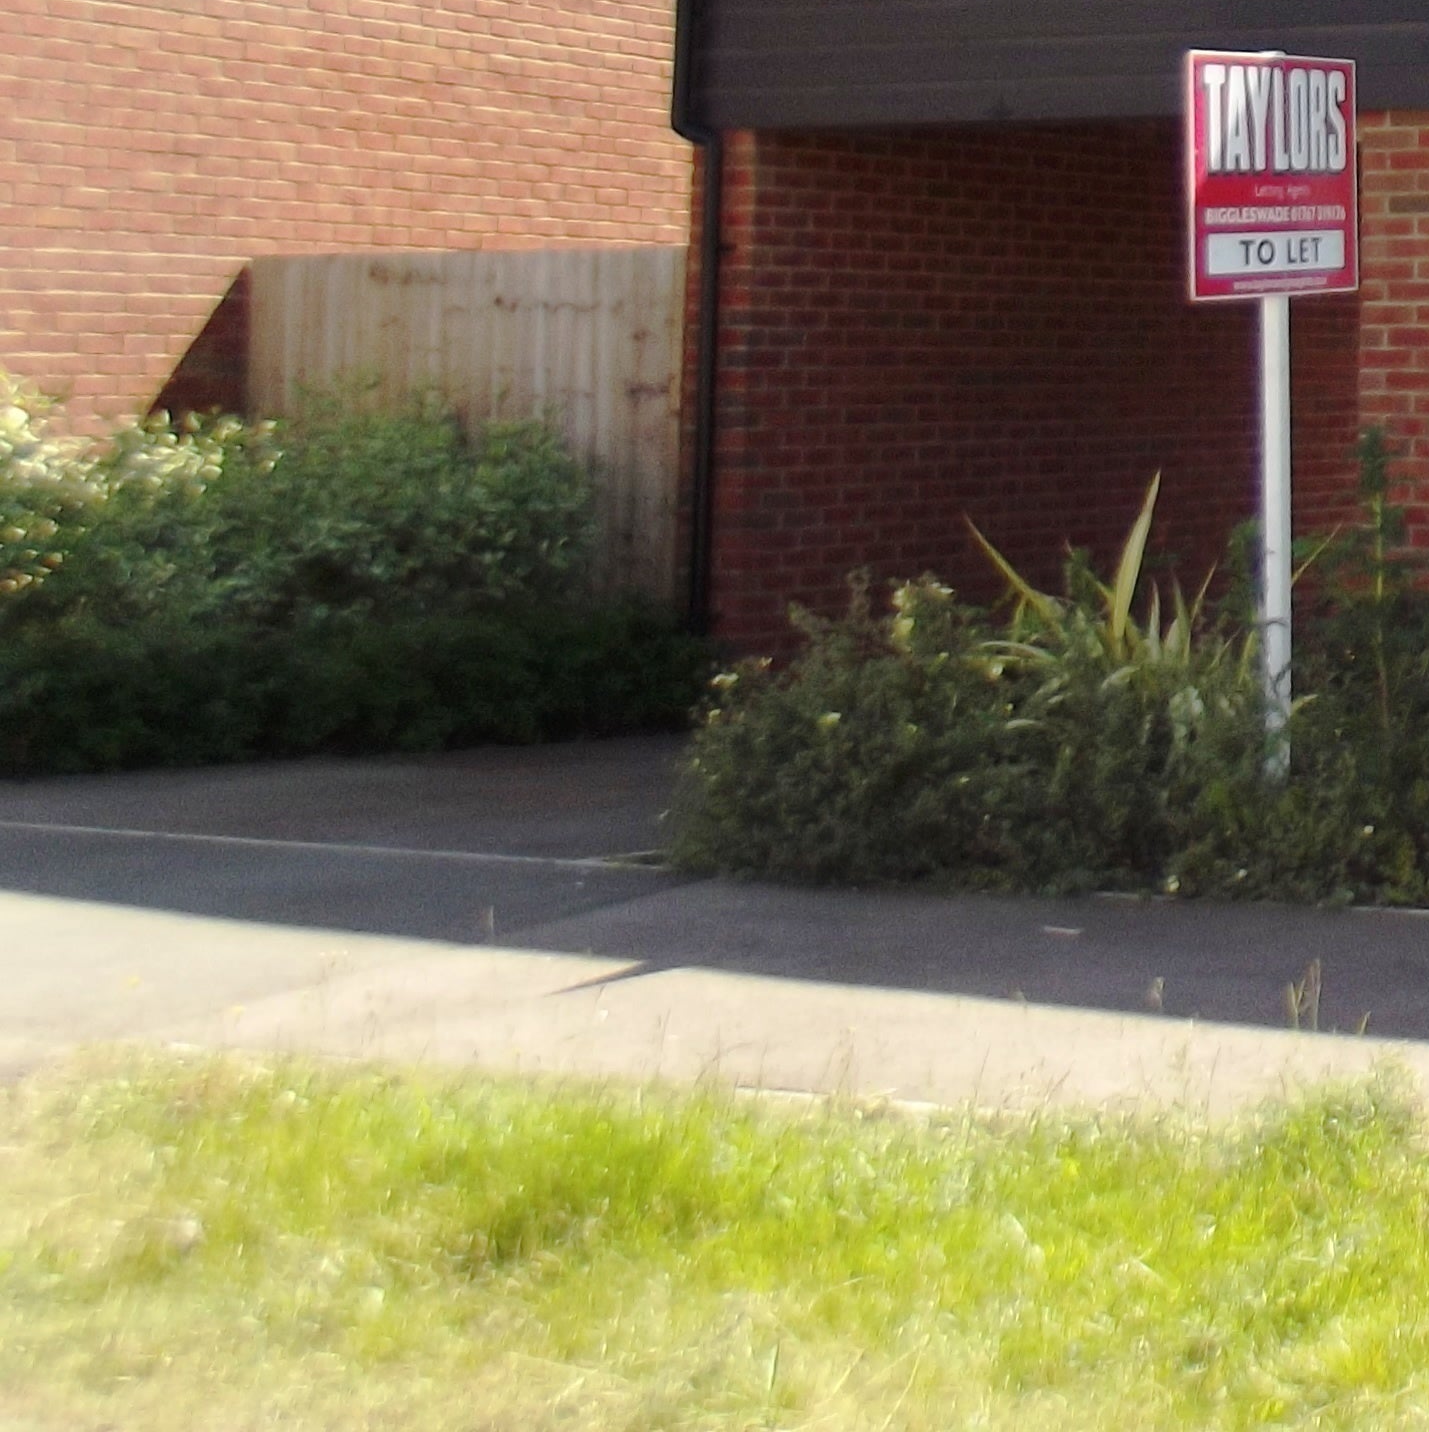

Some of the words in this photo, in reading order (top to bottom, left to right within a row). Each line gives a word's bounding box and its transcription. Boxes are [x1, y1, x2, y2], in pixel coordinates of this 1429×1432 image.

[1204, 64, 1347, 174] TAYLORS
[1204, 206, 1290, 225] BIGGLESWADE
[1239, 239, 1275, 265] TO
[1287, 237, 1322, 264] LET
